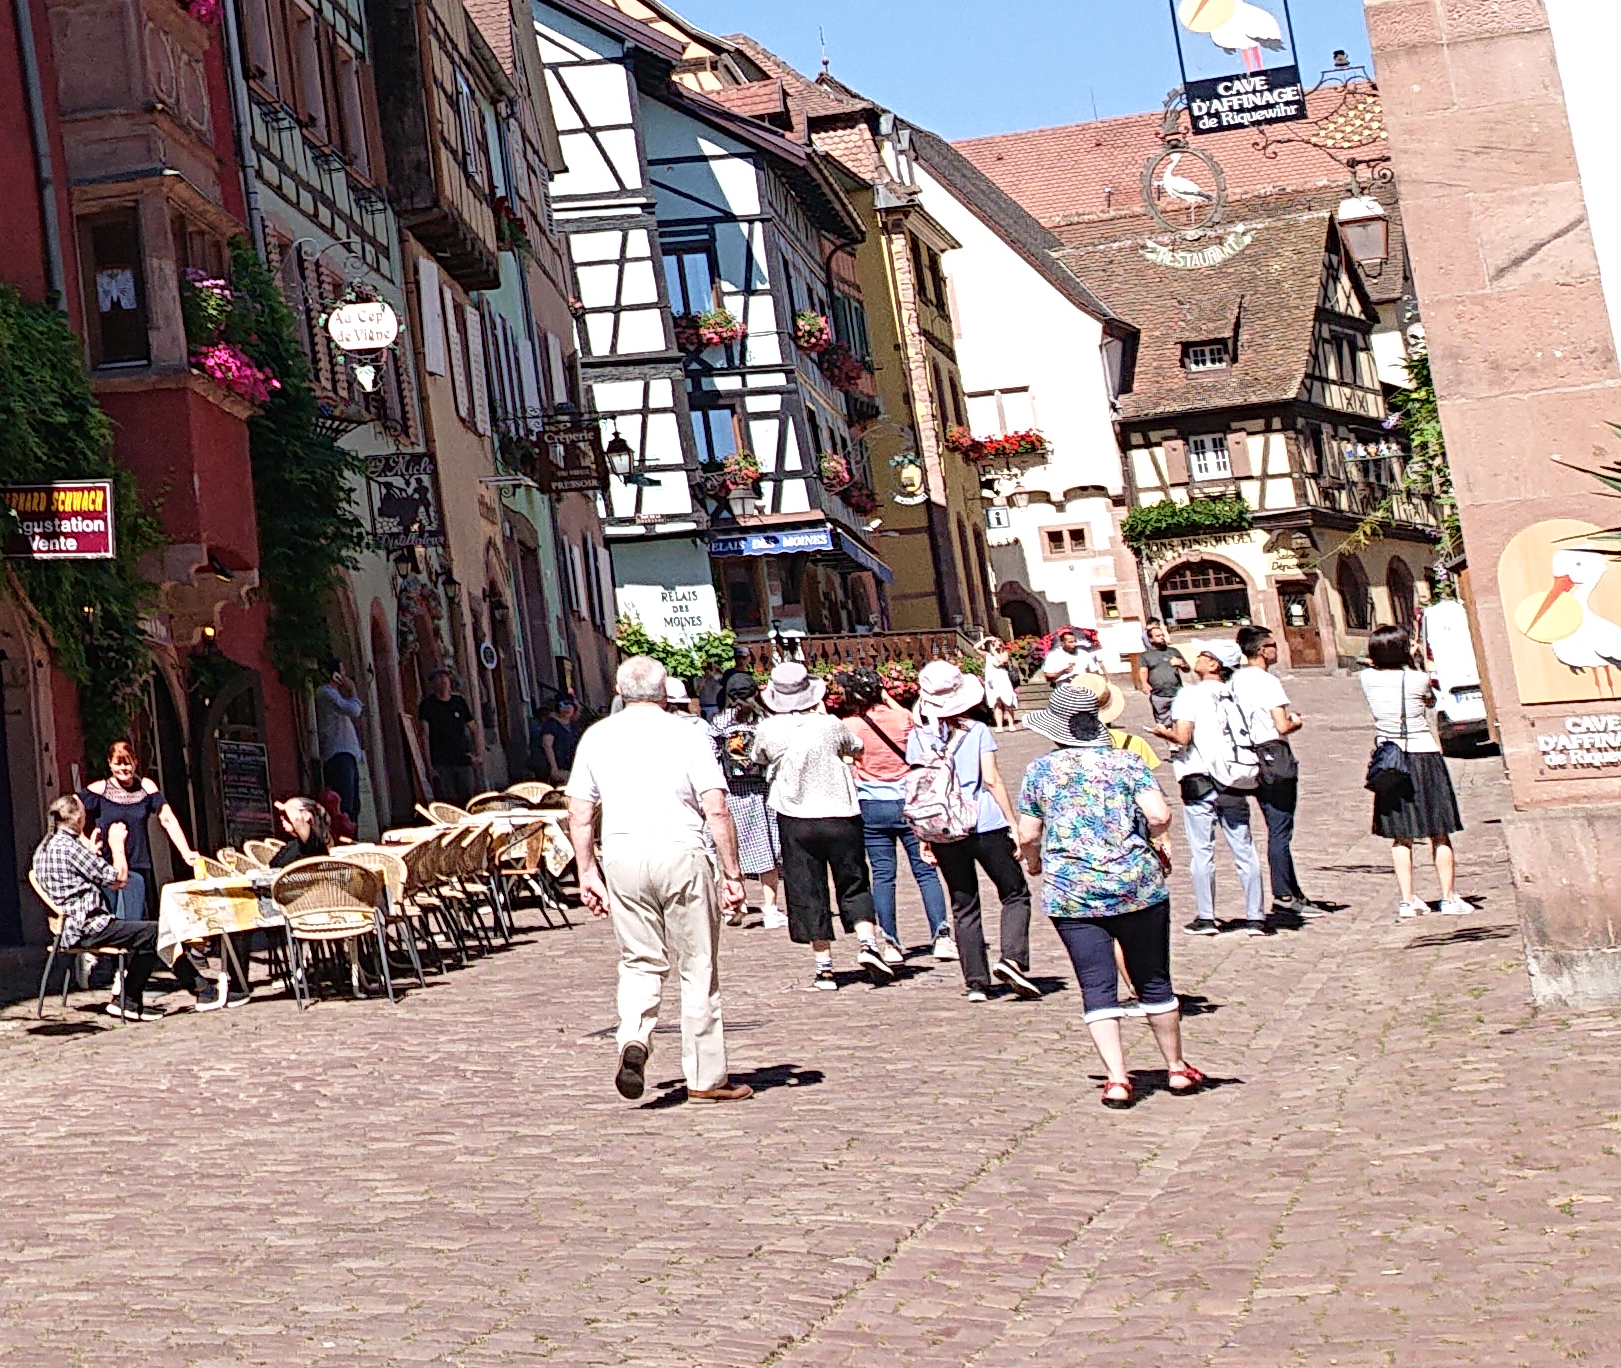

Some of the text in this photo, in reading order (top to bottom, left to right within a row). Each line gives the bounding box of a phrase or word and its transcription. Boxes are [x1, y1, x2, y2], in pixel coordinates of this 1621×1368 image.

[1217, 75, 1269, 97] CAVE
[1191, 86, 1300, 117] D'AFFINAGE
[1199, 103, 1298, 130] de Riquewihr
[1157, 236, 1240, 268] RESTAURANT
[50, 489, 105, 512] SCHWACH
[22, 515, 105, 535] gustation
[28, 535, 78, 552] Vente
[660, 590, 698, 602] RELAIS
[671, 604, 689, 614] DES
[663, 615, 703, 628] MOINES
[1564, 715, 1621, 733] CAVE
[1545, 750, 1567, 766] de
